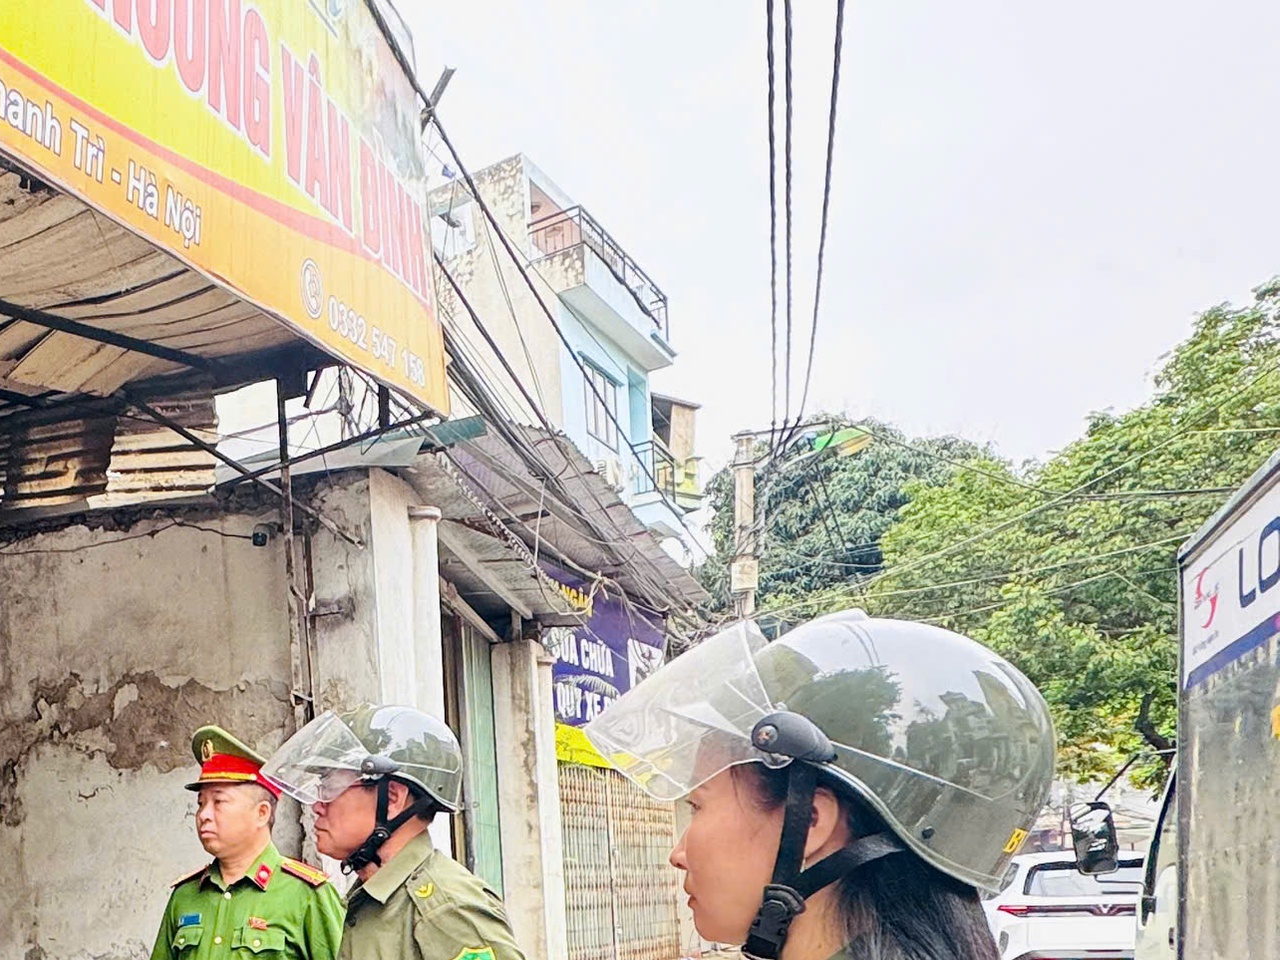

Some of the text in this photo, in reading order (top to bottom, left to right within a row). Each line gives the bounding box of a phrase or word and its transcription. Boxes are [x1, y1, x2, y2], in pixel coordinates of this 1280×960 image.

[70, 117, 106, 184] Trì
[127, 158, 159, 220] Hà
[164, 184, 202, 249] Nội
[281, 43, 353, 234] VÂN
[327, 295, 368, 351] 0332
